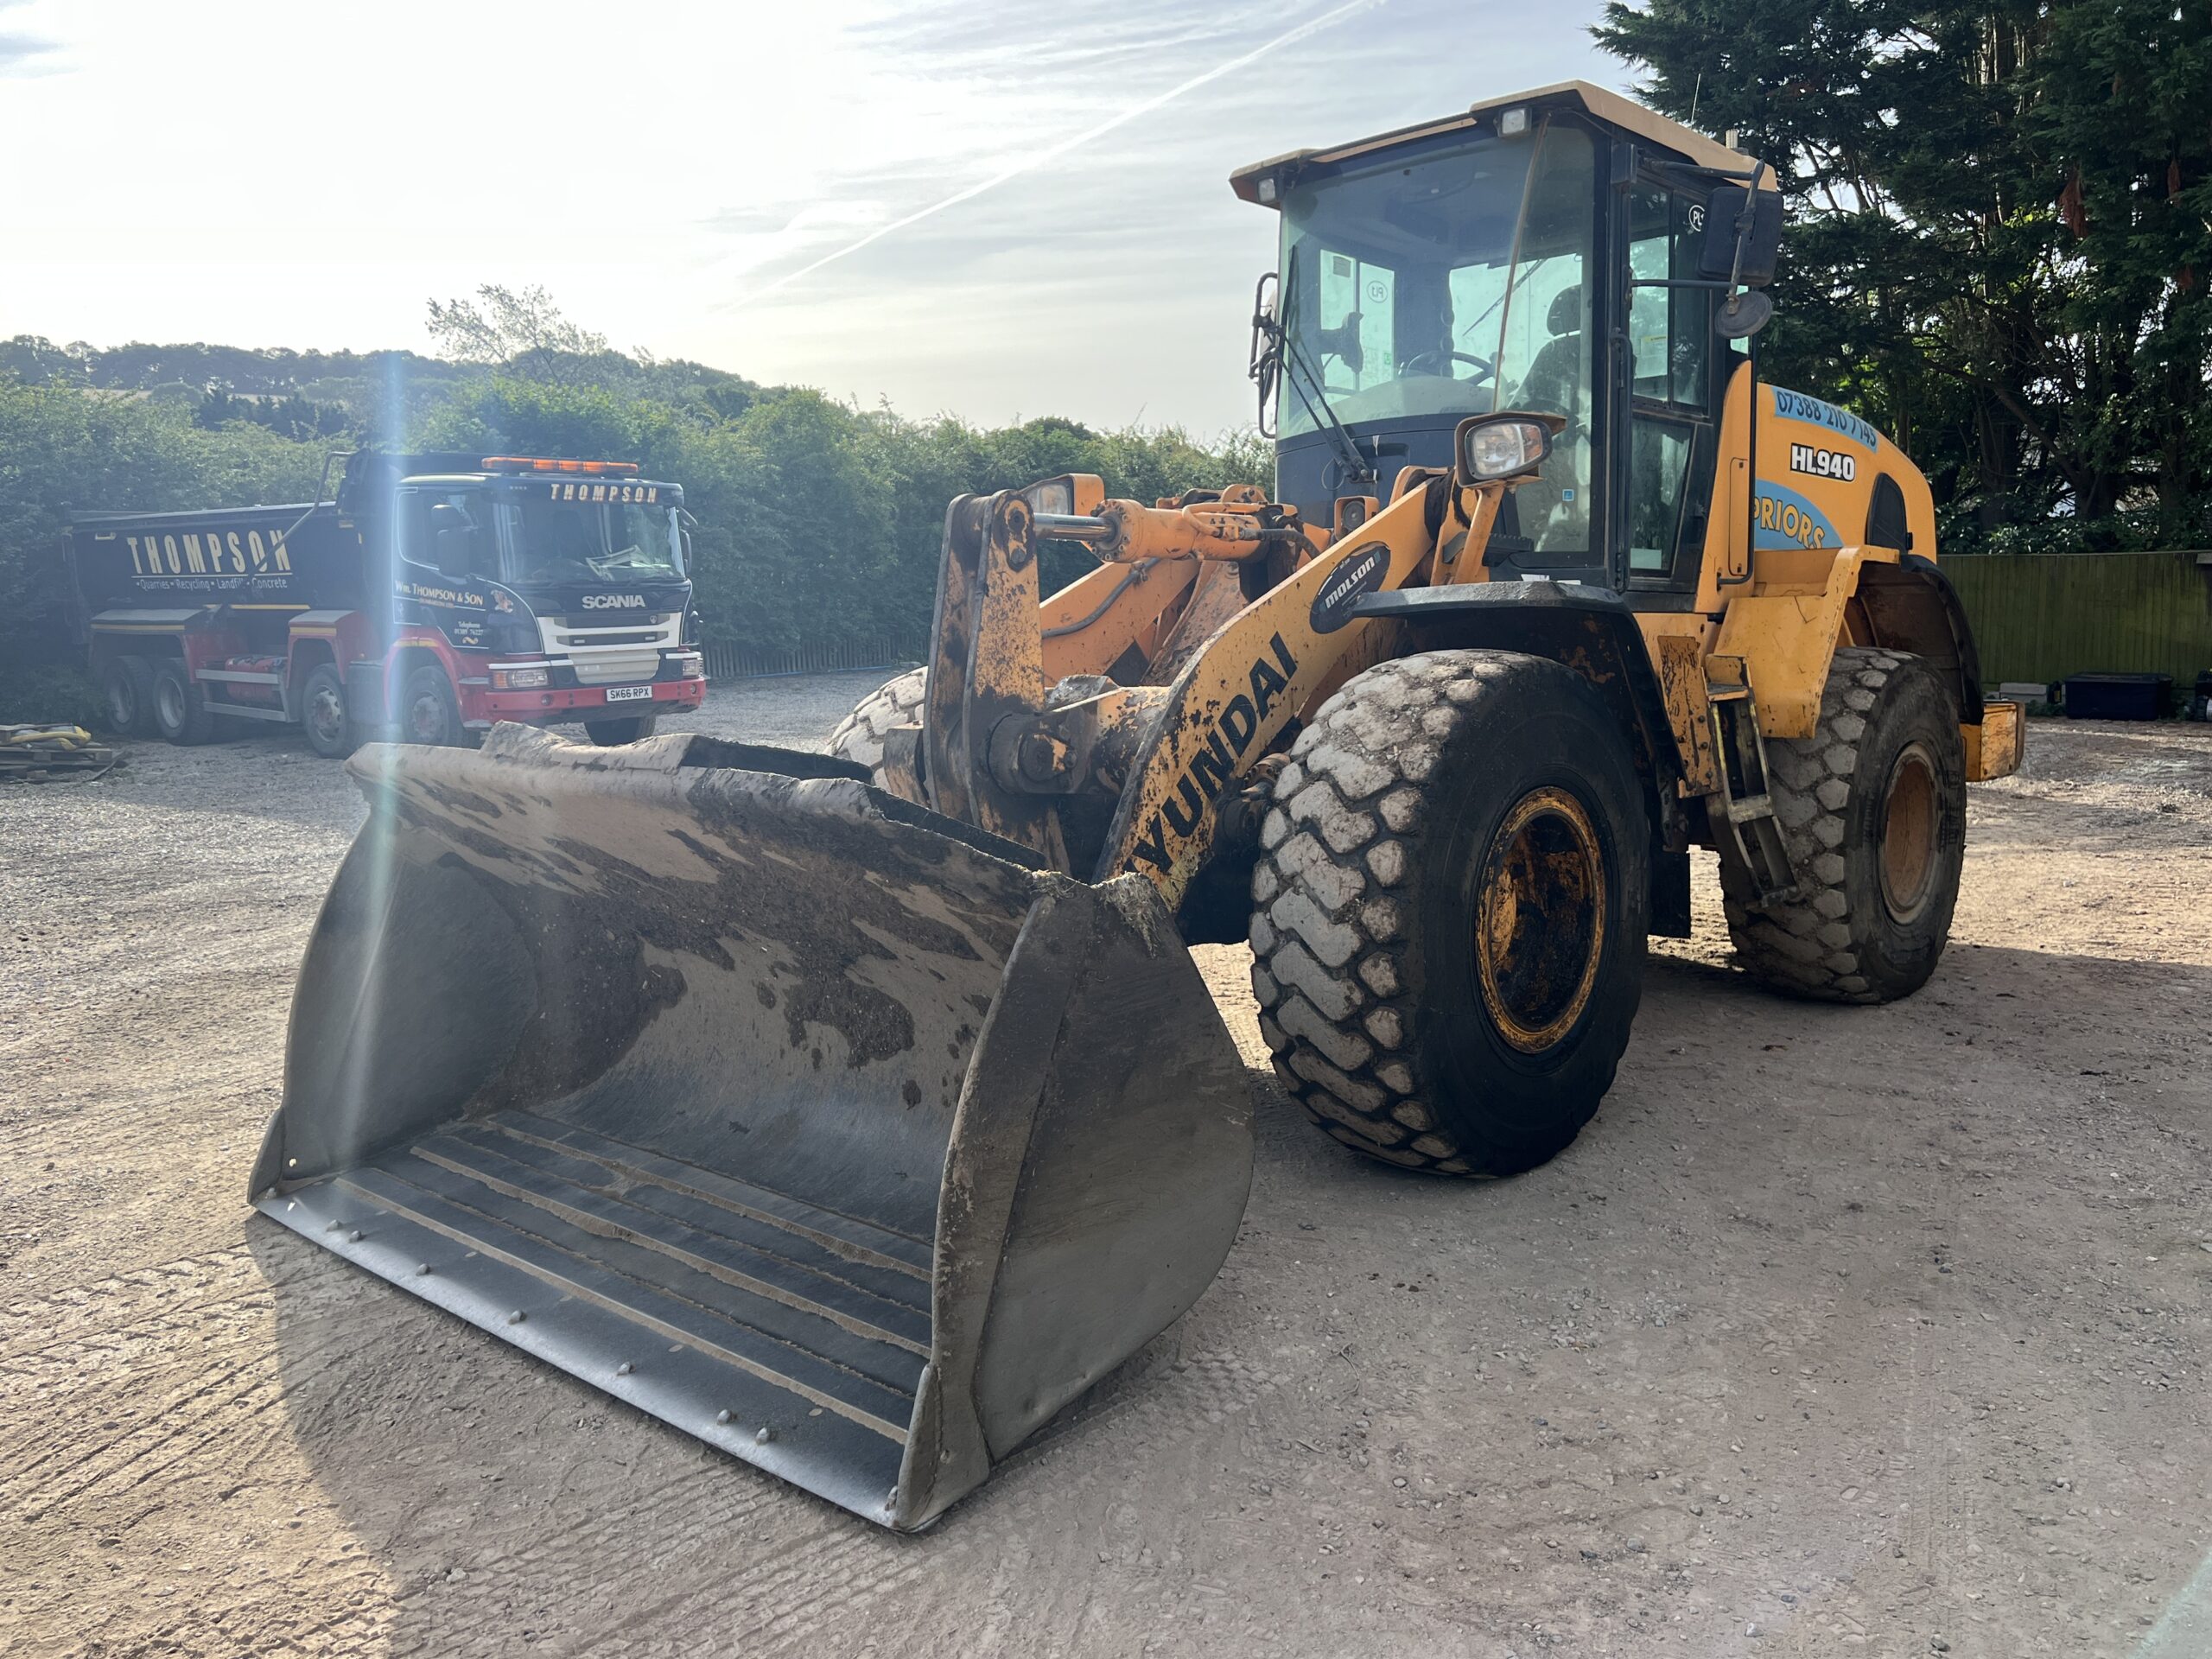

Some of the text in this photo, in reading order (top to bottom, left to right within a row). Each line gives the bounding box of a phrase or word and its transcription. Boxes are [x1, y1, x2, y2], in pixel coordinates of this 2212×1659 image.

[1777, 391, 1822, 422] 07388
[1823, 404, 1847, 431] 210
[1791, 443, 1855, 481] HL940
[550, 483, 657, 503] THOMPSON
[126, 530, 291, 574] THOMPSON
[175, 578, 211, 591] Recycling
[412, 582, 455, 602] THOMPSON
[464, 591, 484, 606] SON
[582, 594, 646, 609] SCANIA
[610, 686, 649, 700] SK66 RPX
[1122, 631, 1298, 874] YUNDAI
